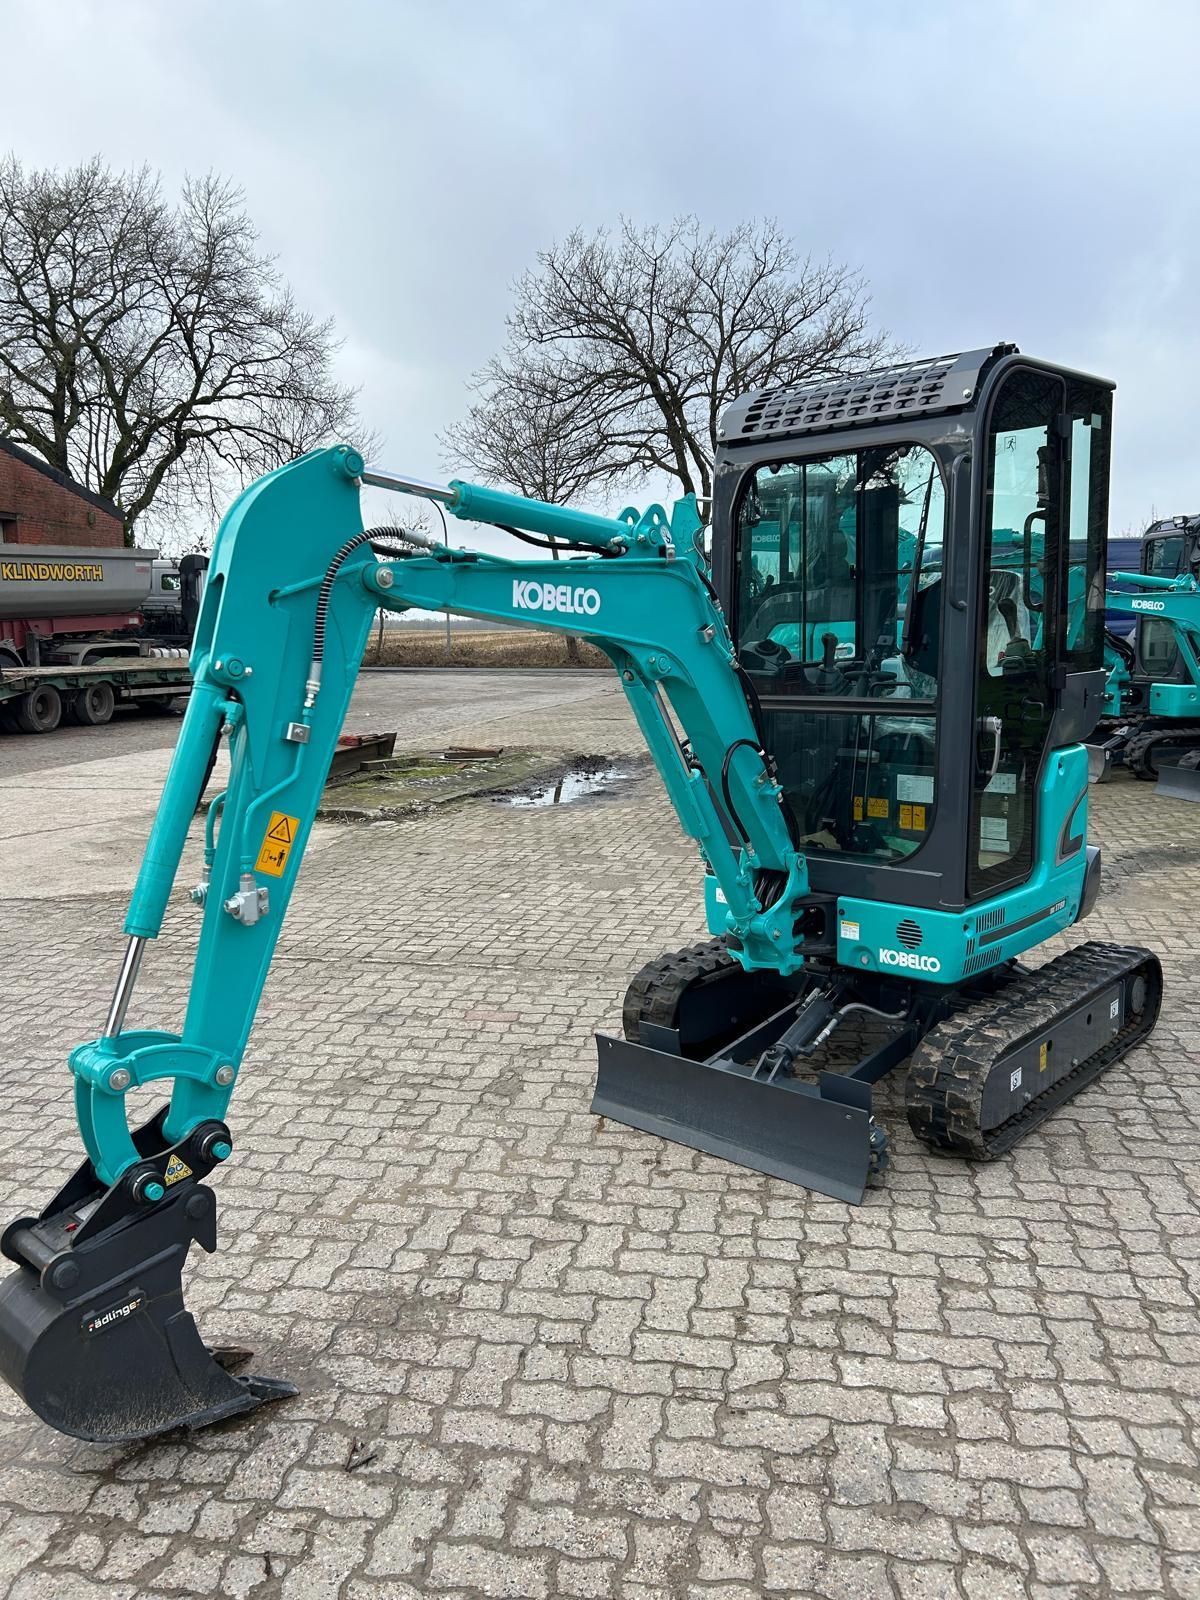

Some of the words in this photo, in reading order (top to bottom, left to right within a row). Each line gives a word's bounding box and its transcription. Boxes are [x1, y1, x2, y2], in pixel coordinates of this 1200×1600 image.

[1, 562, 104, 581] KLINDWORTH
[512, 579, 601, 616] KOBELCO
[1131, 599, 1165, 611] KOBELCO
[879, 948, 941, 973] KOBELCO
